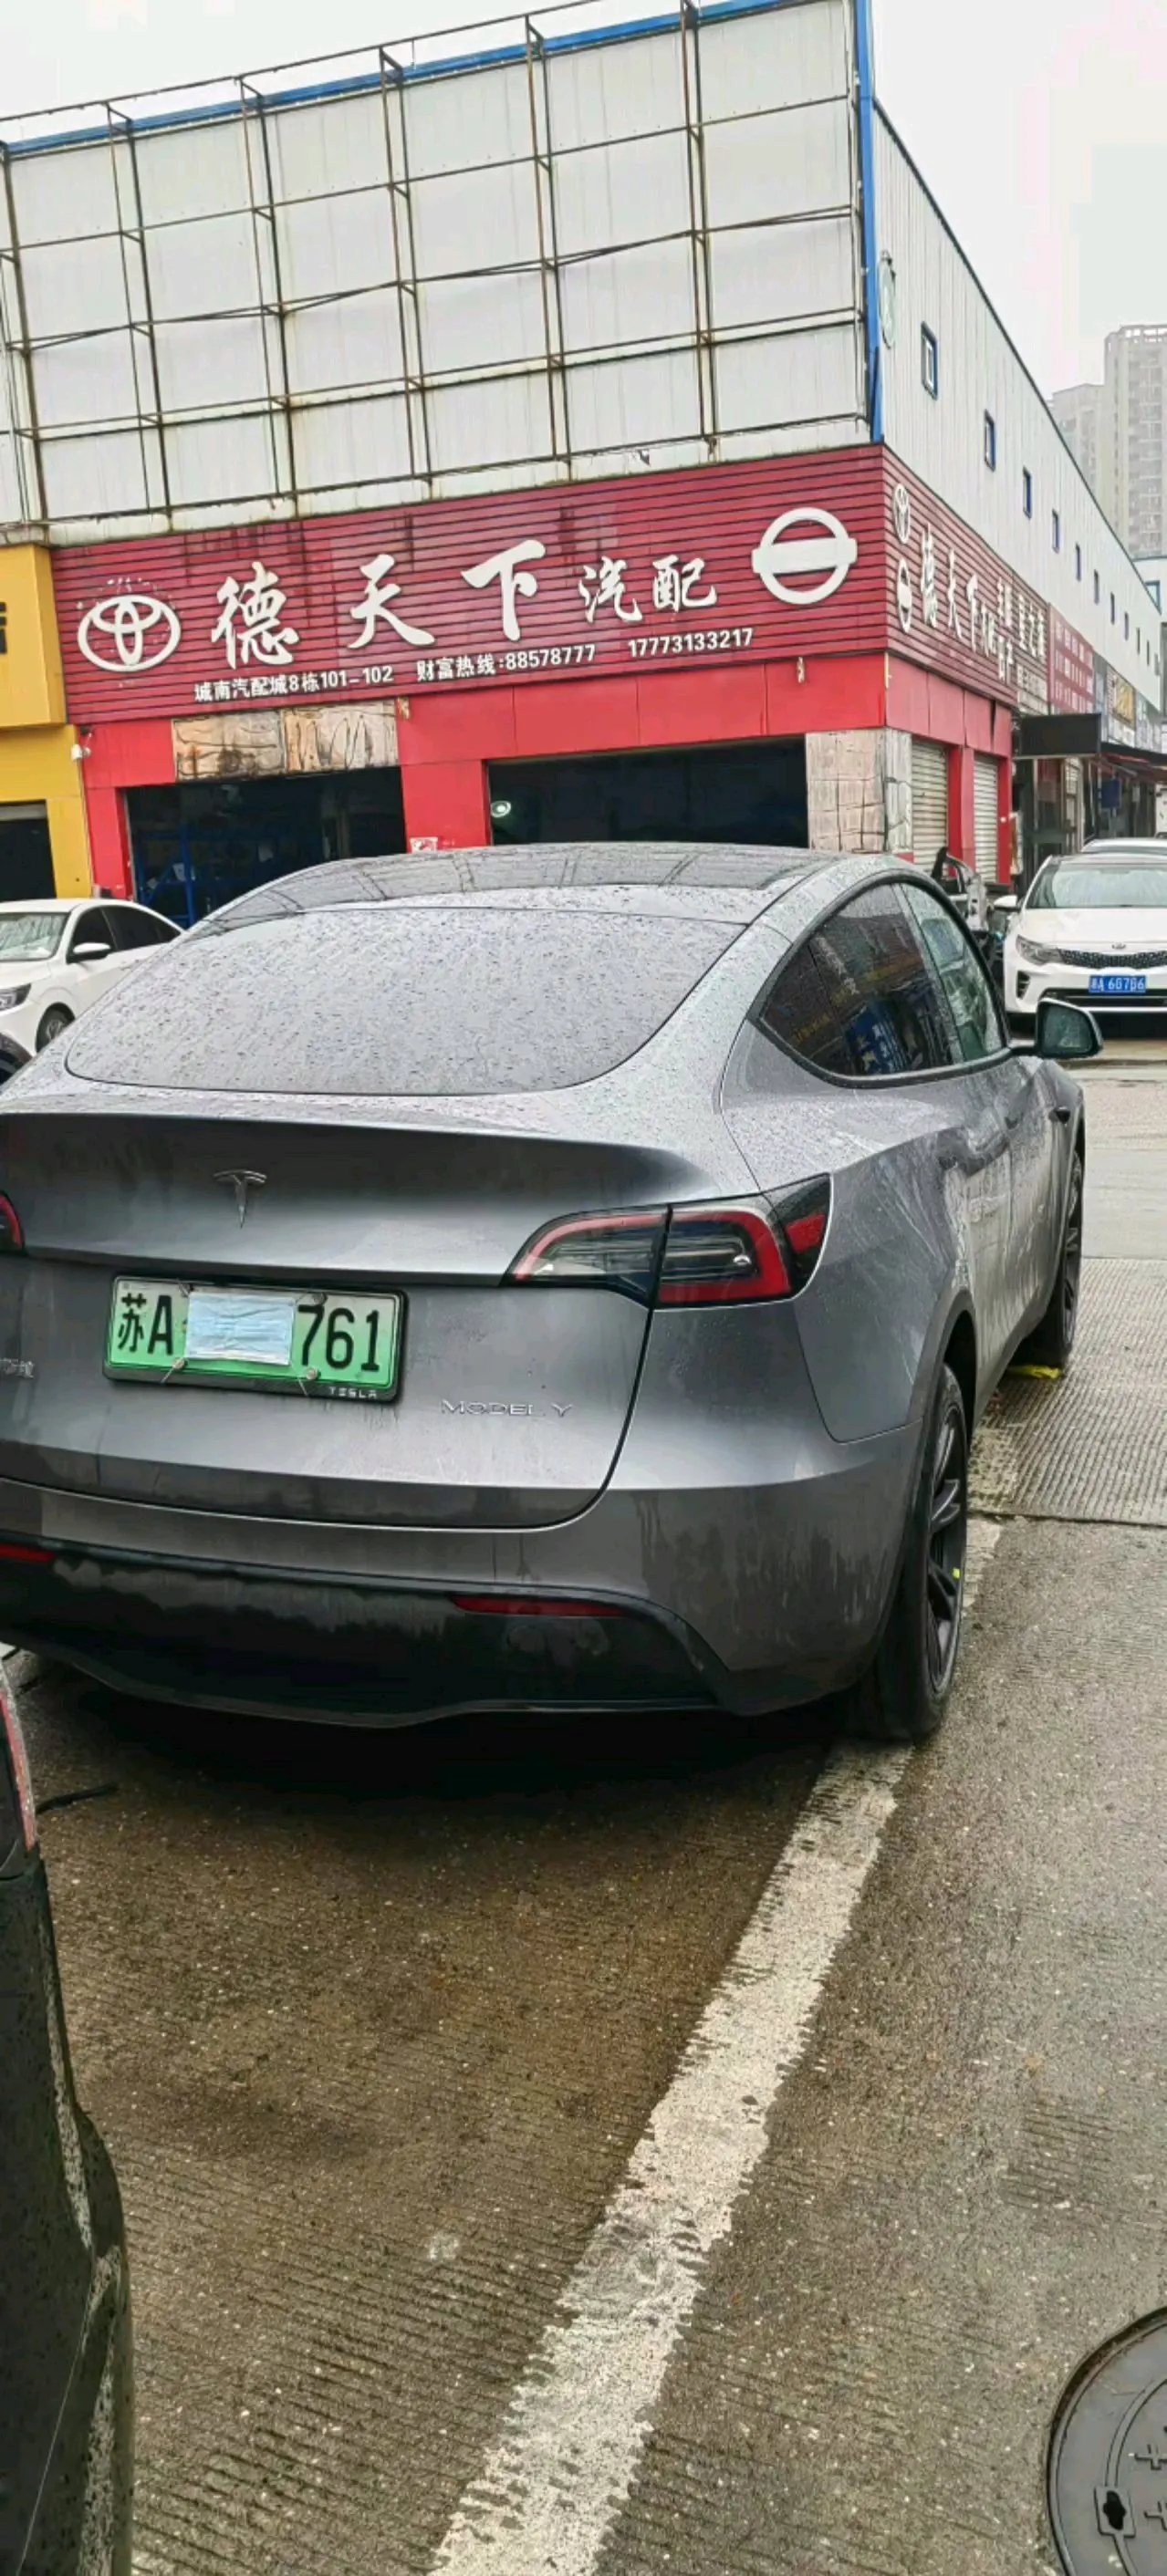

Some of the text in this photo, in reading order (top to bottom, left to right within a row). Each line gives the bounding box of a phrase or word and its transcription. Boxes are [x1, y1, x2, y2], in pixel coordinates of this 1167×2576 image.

[628, 628, 753, 658] 17773133217
[329, 1386, 377, 1399] TESLA
[442, 1398, 573, 1418] MODEL Y
